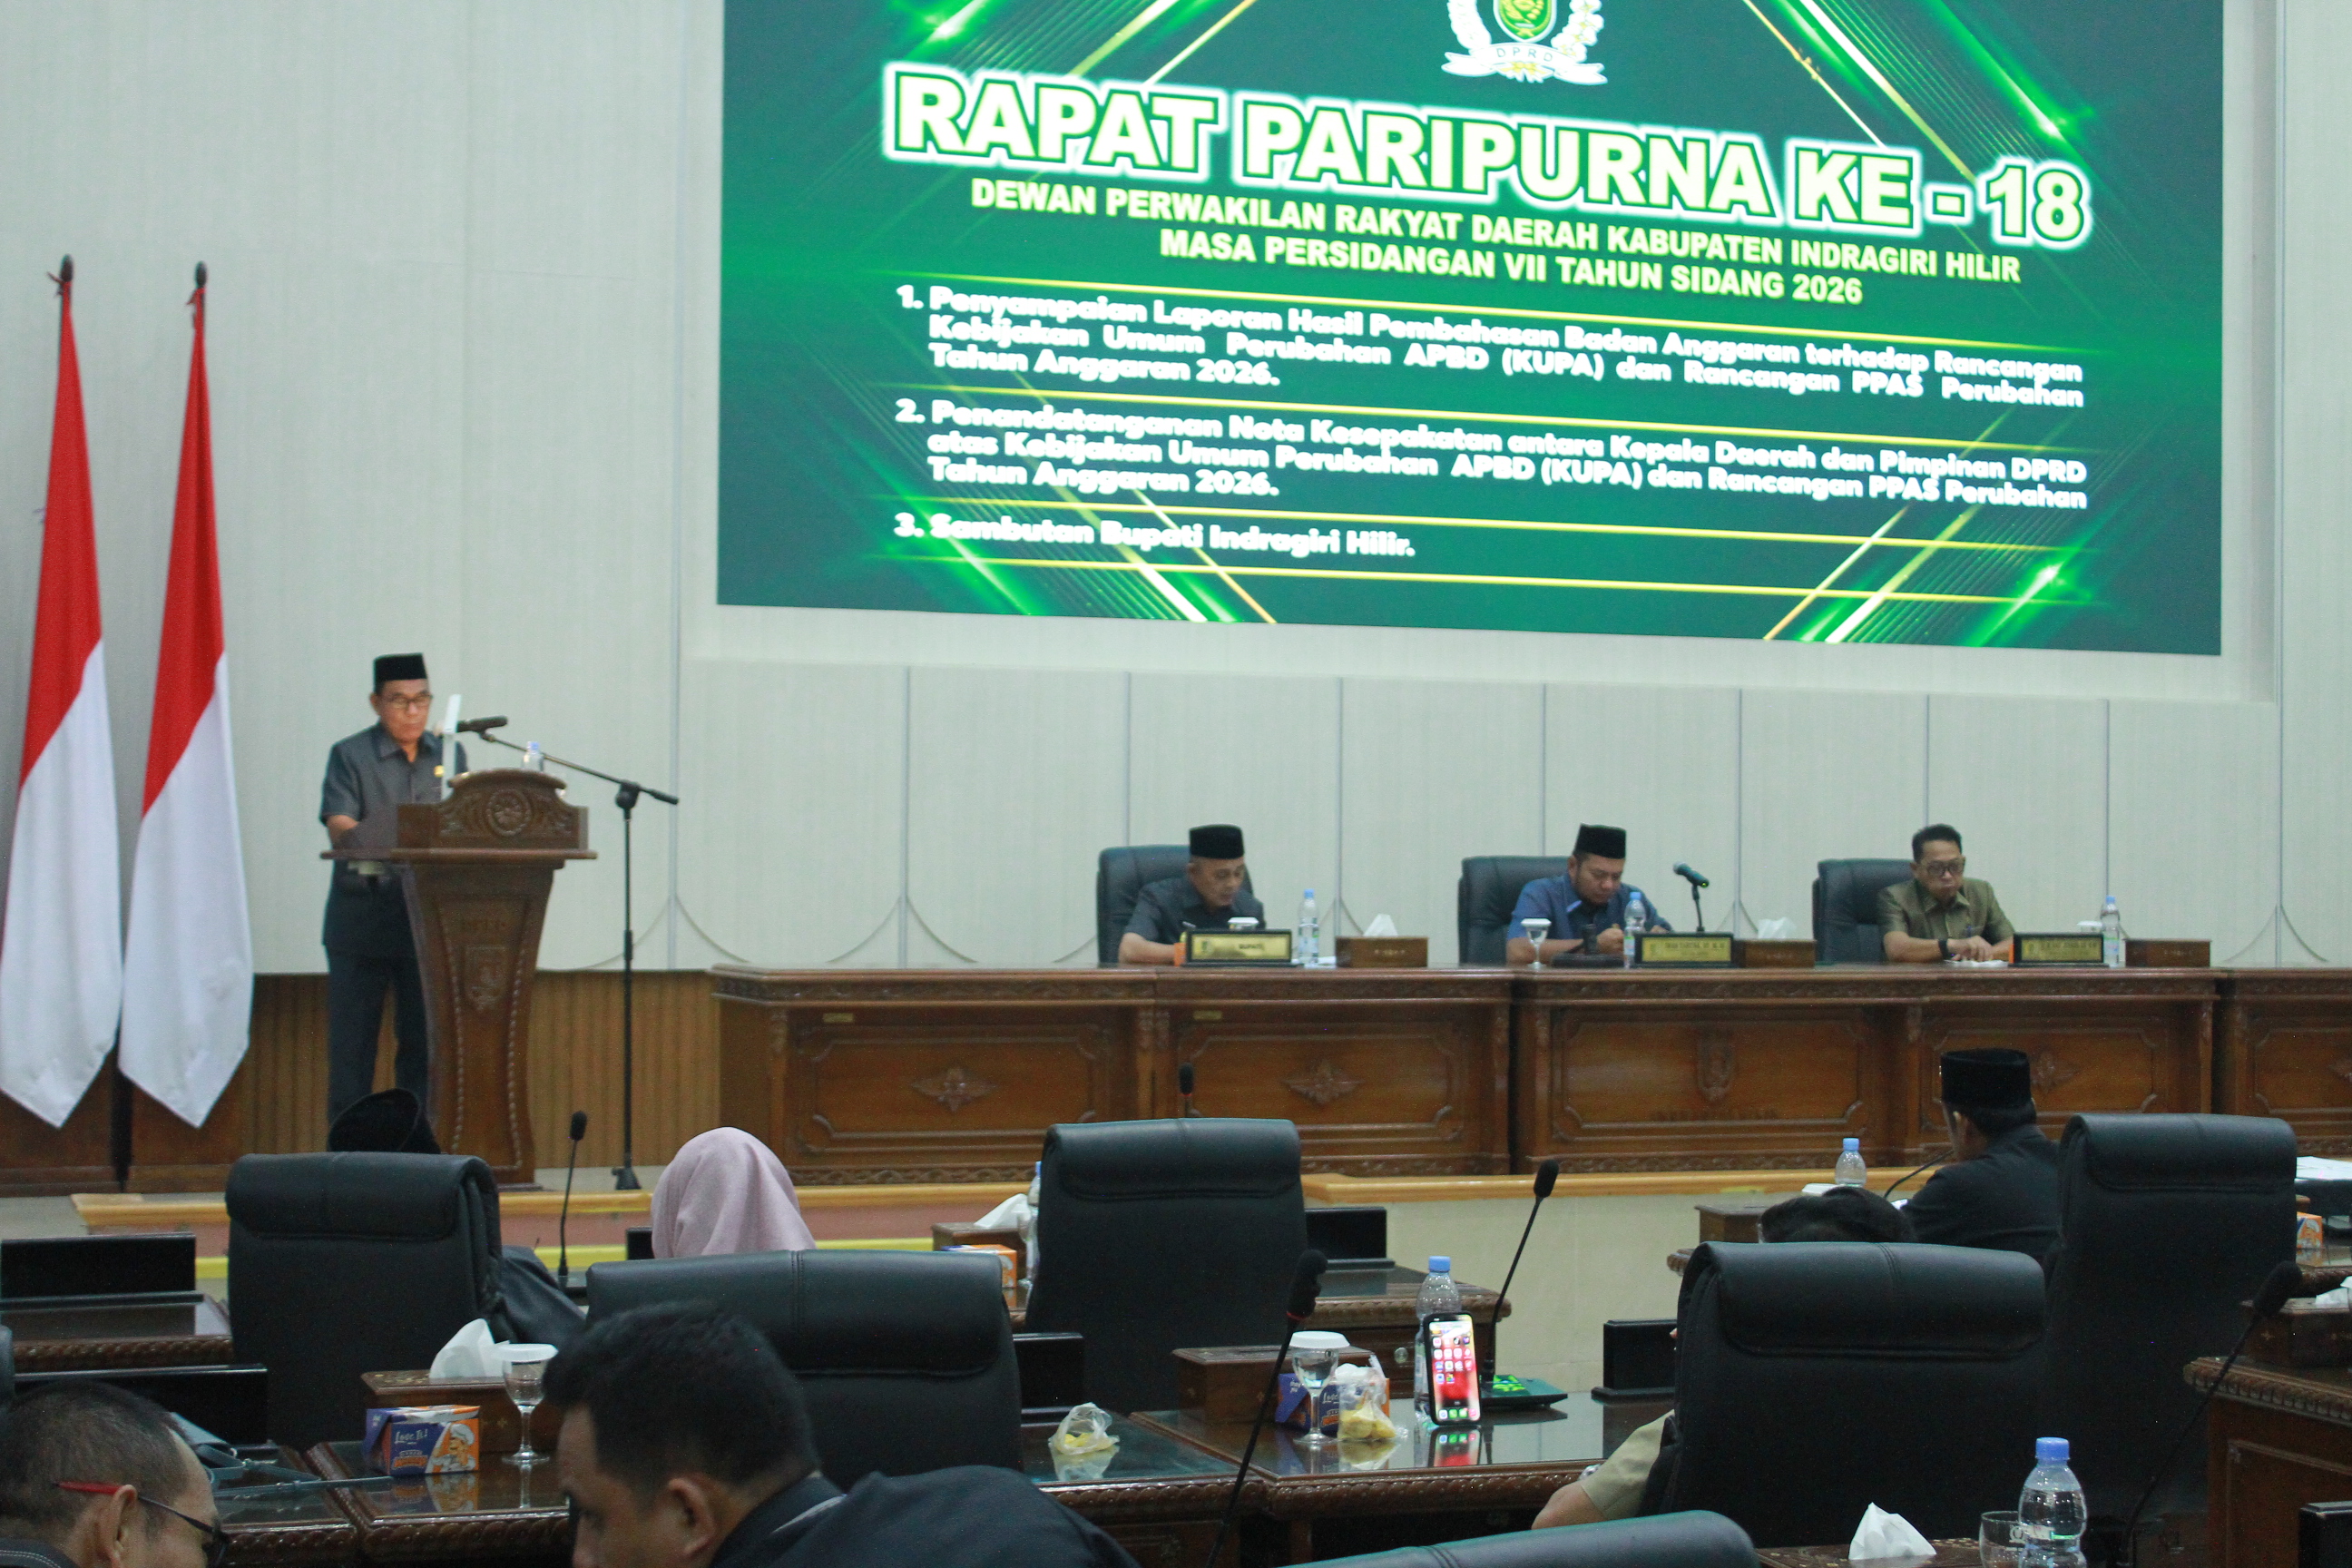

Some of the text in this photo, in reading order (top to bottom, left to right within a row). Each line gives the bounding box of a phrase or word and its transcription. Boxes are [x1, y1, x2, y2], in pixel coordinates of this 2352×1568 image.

[1496, 46, 1553, 62] DPRD
[890, 68, 1222, 177] RAPAT
[1240, 97, 1780, 220] PARIPURNA
[1791, 142, 1915, 232] KE
[972, 178, 2021, 283] DEWAN PERWAKILAN RAKYAT DAERAH KABUPATEN INDRAGIRI HILIR
[1161, 228, 1863, 305] MASA PERSIDANGAN VII TAHUN SIDANG 2026
[897, 284, 2082, 384] 1. Penyampaian Laporan Hasil Pembahasan Badan Anggaran terhadap Rancangan
[927, 341, 1280, 387] Tahun Anggaran 2026.
[928, 313, 2084, 407] Kebijakan Umum Perubahan APBD (KUPA) dan Rancangan PPAS Perubahan
[895, 397, 2087, 485] 2. Penandatanganan Nota Kesepakatan antara Kepala Daerah dan Pimpinan DPRD
[926, 430, 2088, 509] atas Kebijakan Umum Perubahan APBD (KUPA) dan Rancangan PPAS Perubahan
[926, 456, 1279, 496] Tahun Anggaran 2026.
[894, 512, 1416, 558] 3. Sambutan Bupati Indragiri Hilir.
